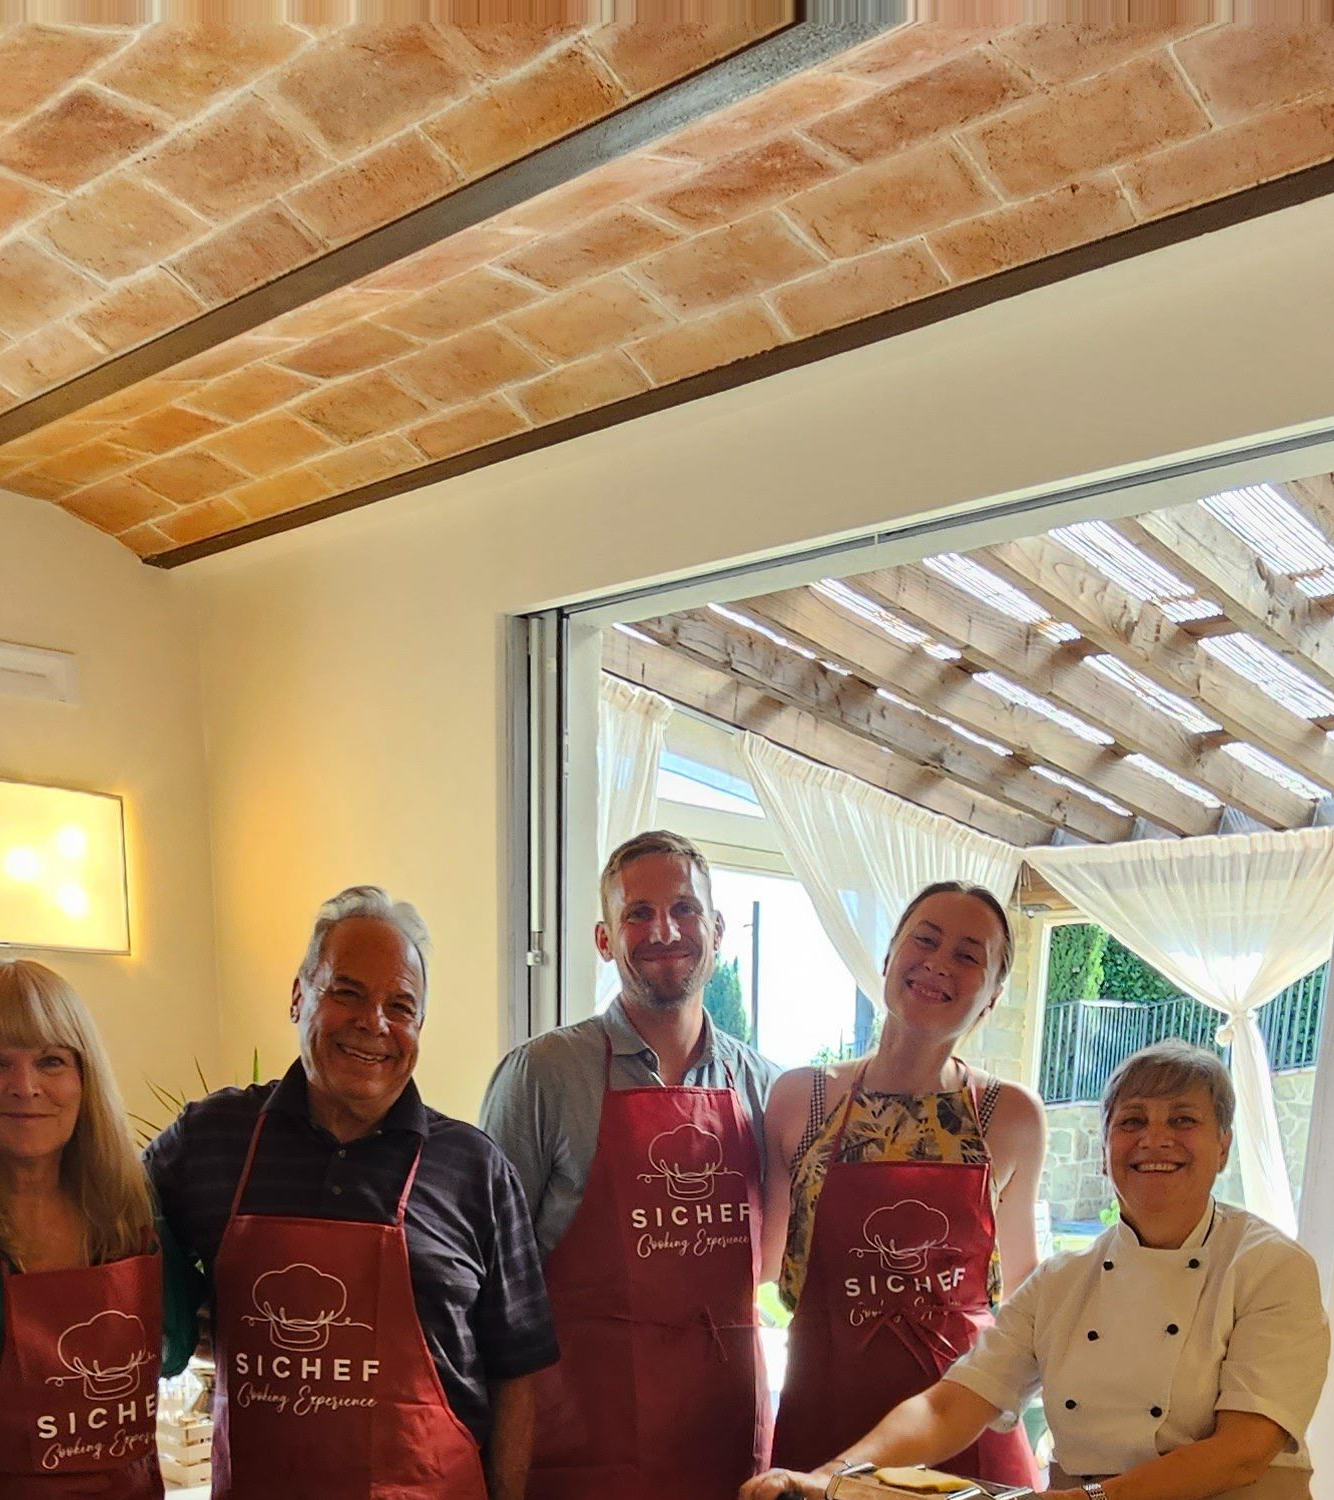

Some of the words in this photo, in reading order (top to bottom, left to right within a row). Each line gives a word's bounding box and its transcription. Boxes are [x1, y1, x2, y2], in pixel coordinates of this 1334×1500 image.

[630, 1202, 751, 1229] SICHEF
[636, 1232, 691, 1259] Cooking
[844, 1267, 966, 1297] SICHEF
[235, 1352, 380, 1382] SICHEF
[237, 1381, 289, 1413] Cooking
[293, 1384, 378, 1416] Experience
[36, 1393, 157, 1439] SICHE
[41, 1437, 103, 1470] Cooking
